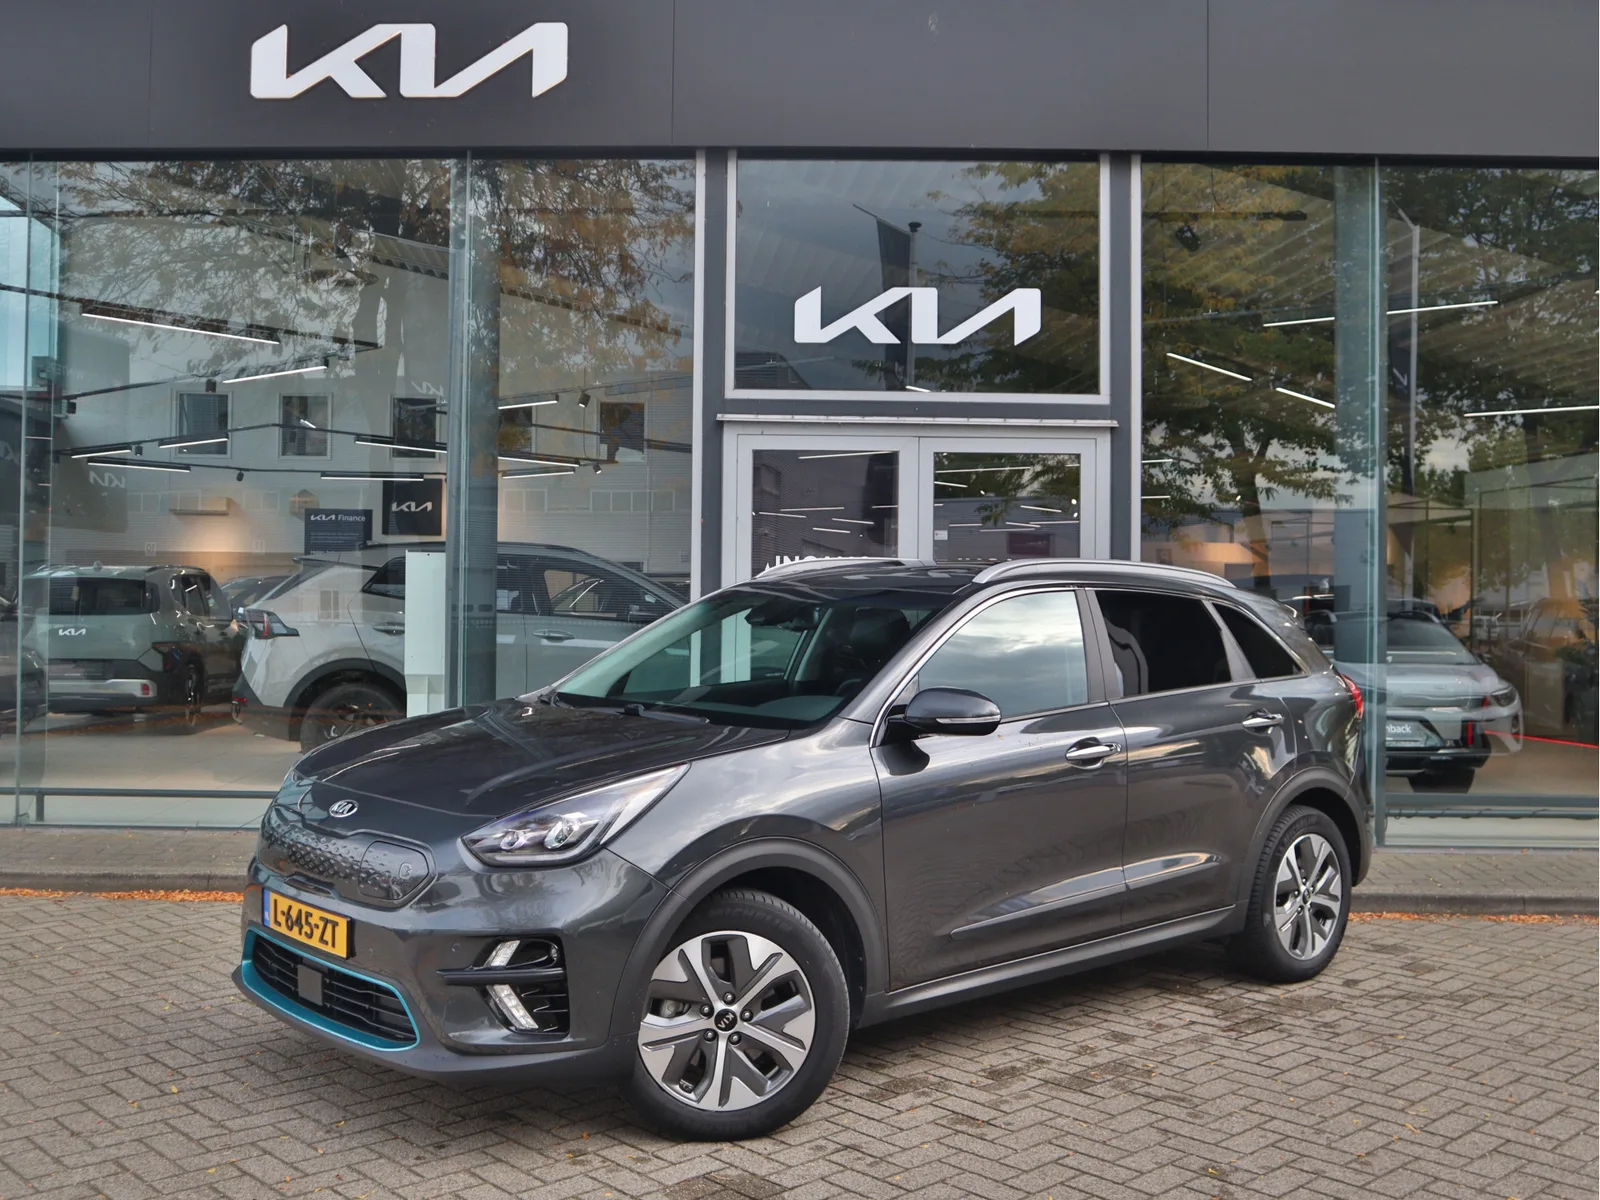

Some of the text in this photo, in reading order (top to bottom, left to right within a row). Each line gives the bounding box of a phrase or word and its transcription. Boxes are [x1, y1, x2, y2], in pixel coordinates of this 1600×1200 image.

[250, 22, 568, 99] KIA
[794, 285, 1042, 346] KIA
[391, 501, 433, 512] KIA
[338, 514, 366, 522] Finance
[58, 628, 87, 636] KIA
[273, 898, 339, 949] L-645-ZT
[717, 1012, 735, 1029] KIA
